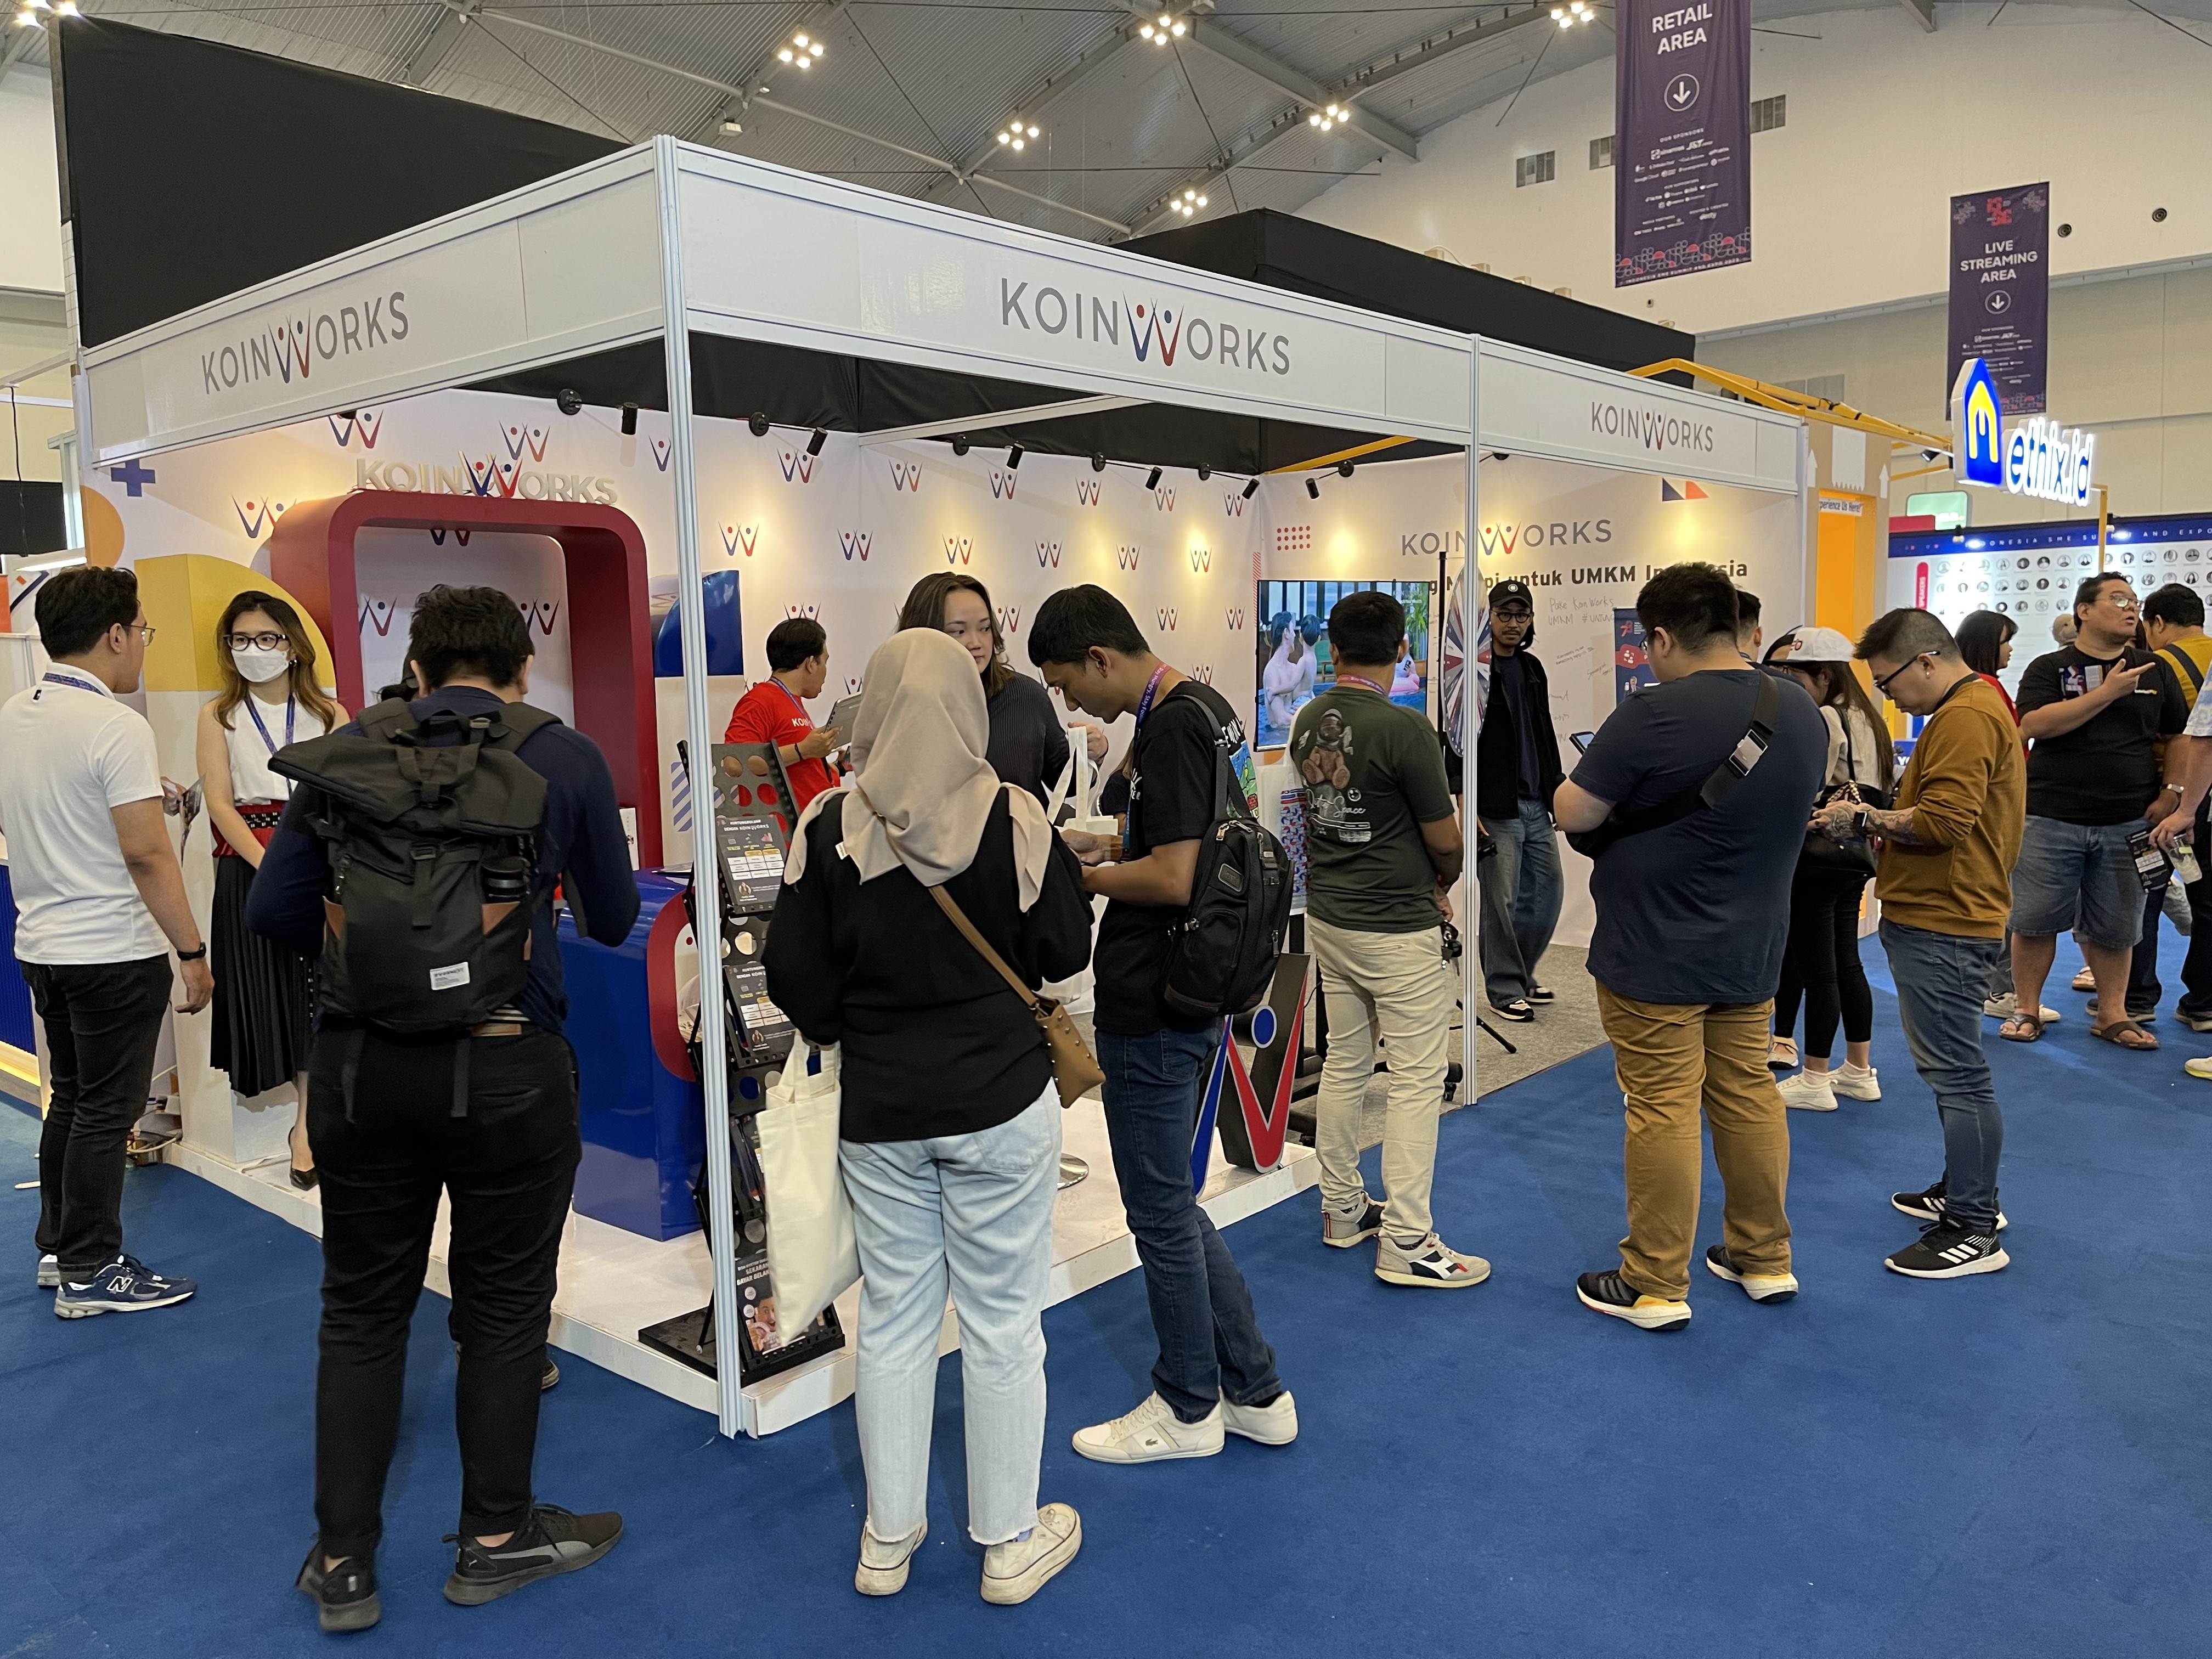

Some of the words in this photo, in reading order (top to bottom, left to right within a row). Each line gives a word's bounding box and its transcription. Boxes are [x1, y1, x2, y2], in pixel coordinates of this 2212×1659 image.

[1652, 3, 1713, 33] RETAIL
[1657, 28, 1707, 55] AREA
[1960, 251, 2038, 272] STREAMING
[1985, 240, 2013, 253] LIVE
[1980, 271, 2017, 283] AREA
[1001, 278, 1290, 375] KOINWORKS
[201, 291, 409, 394] KOINWORKS
[1592, 402, 1713, 452] KOINWORKS
[2006, 417, 2094, 506] ethix.id
[356, 451, 617, 505] KOINWORKS
[1571, 566, 1637, 584] UMKM
